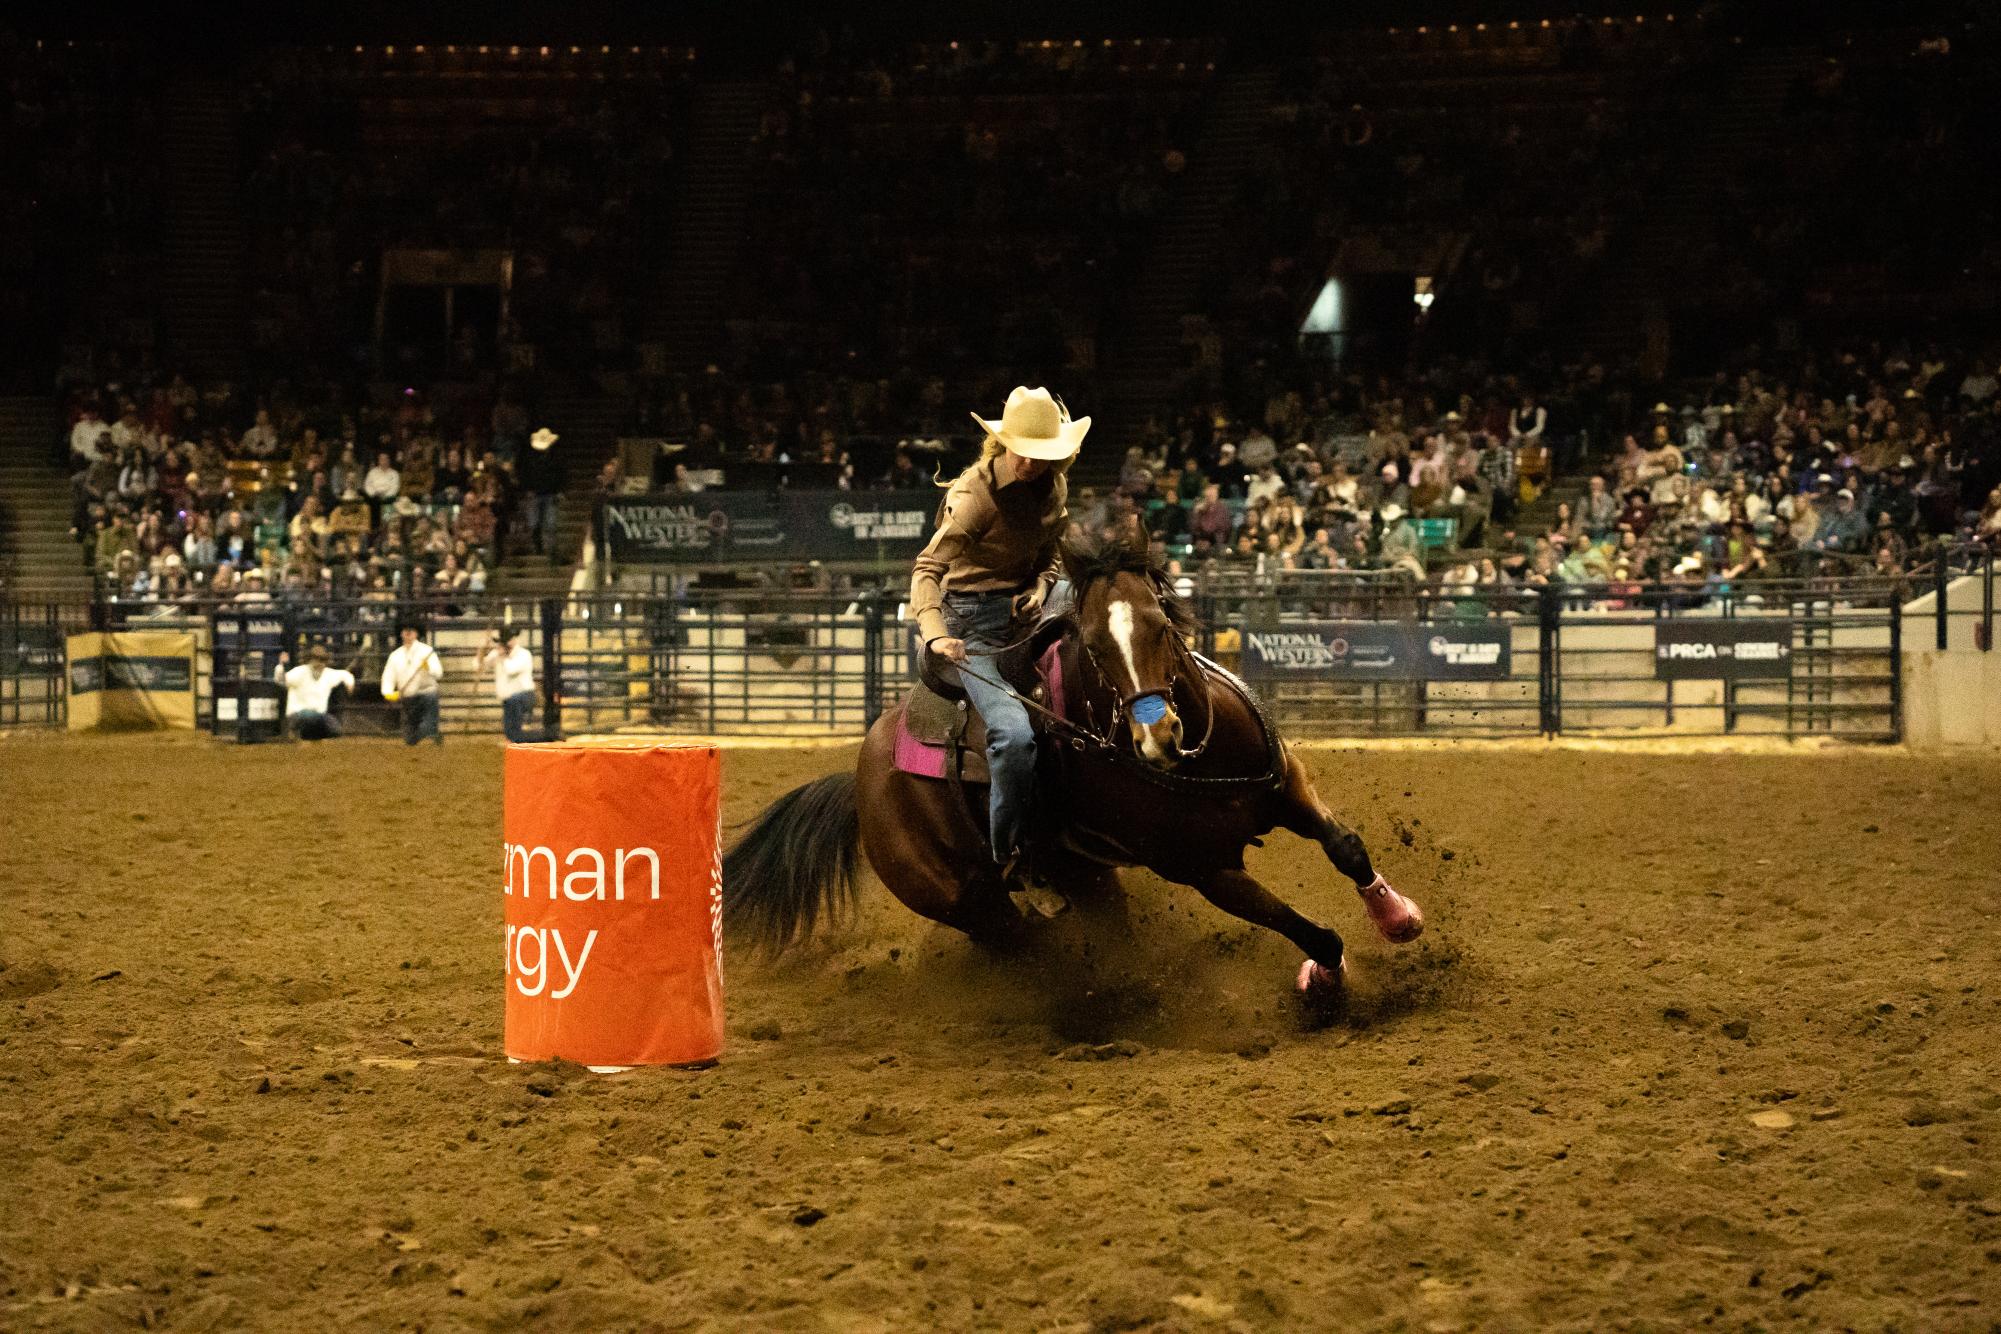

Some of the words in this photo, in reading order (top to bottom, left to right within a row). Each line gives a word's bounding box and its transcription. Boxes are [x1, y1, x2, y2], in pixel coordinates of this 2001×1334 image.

[608, 505, 696, 527] NATIONAL
[1247, 633, 1323, 652] NATIONAL
[1670, 642, 1717, 659] PRCA
[1261, 647, 1335, 662] WESTERN
[505, 924, 599, 999] rgy
